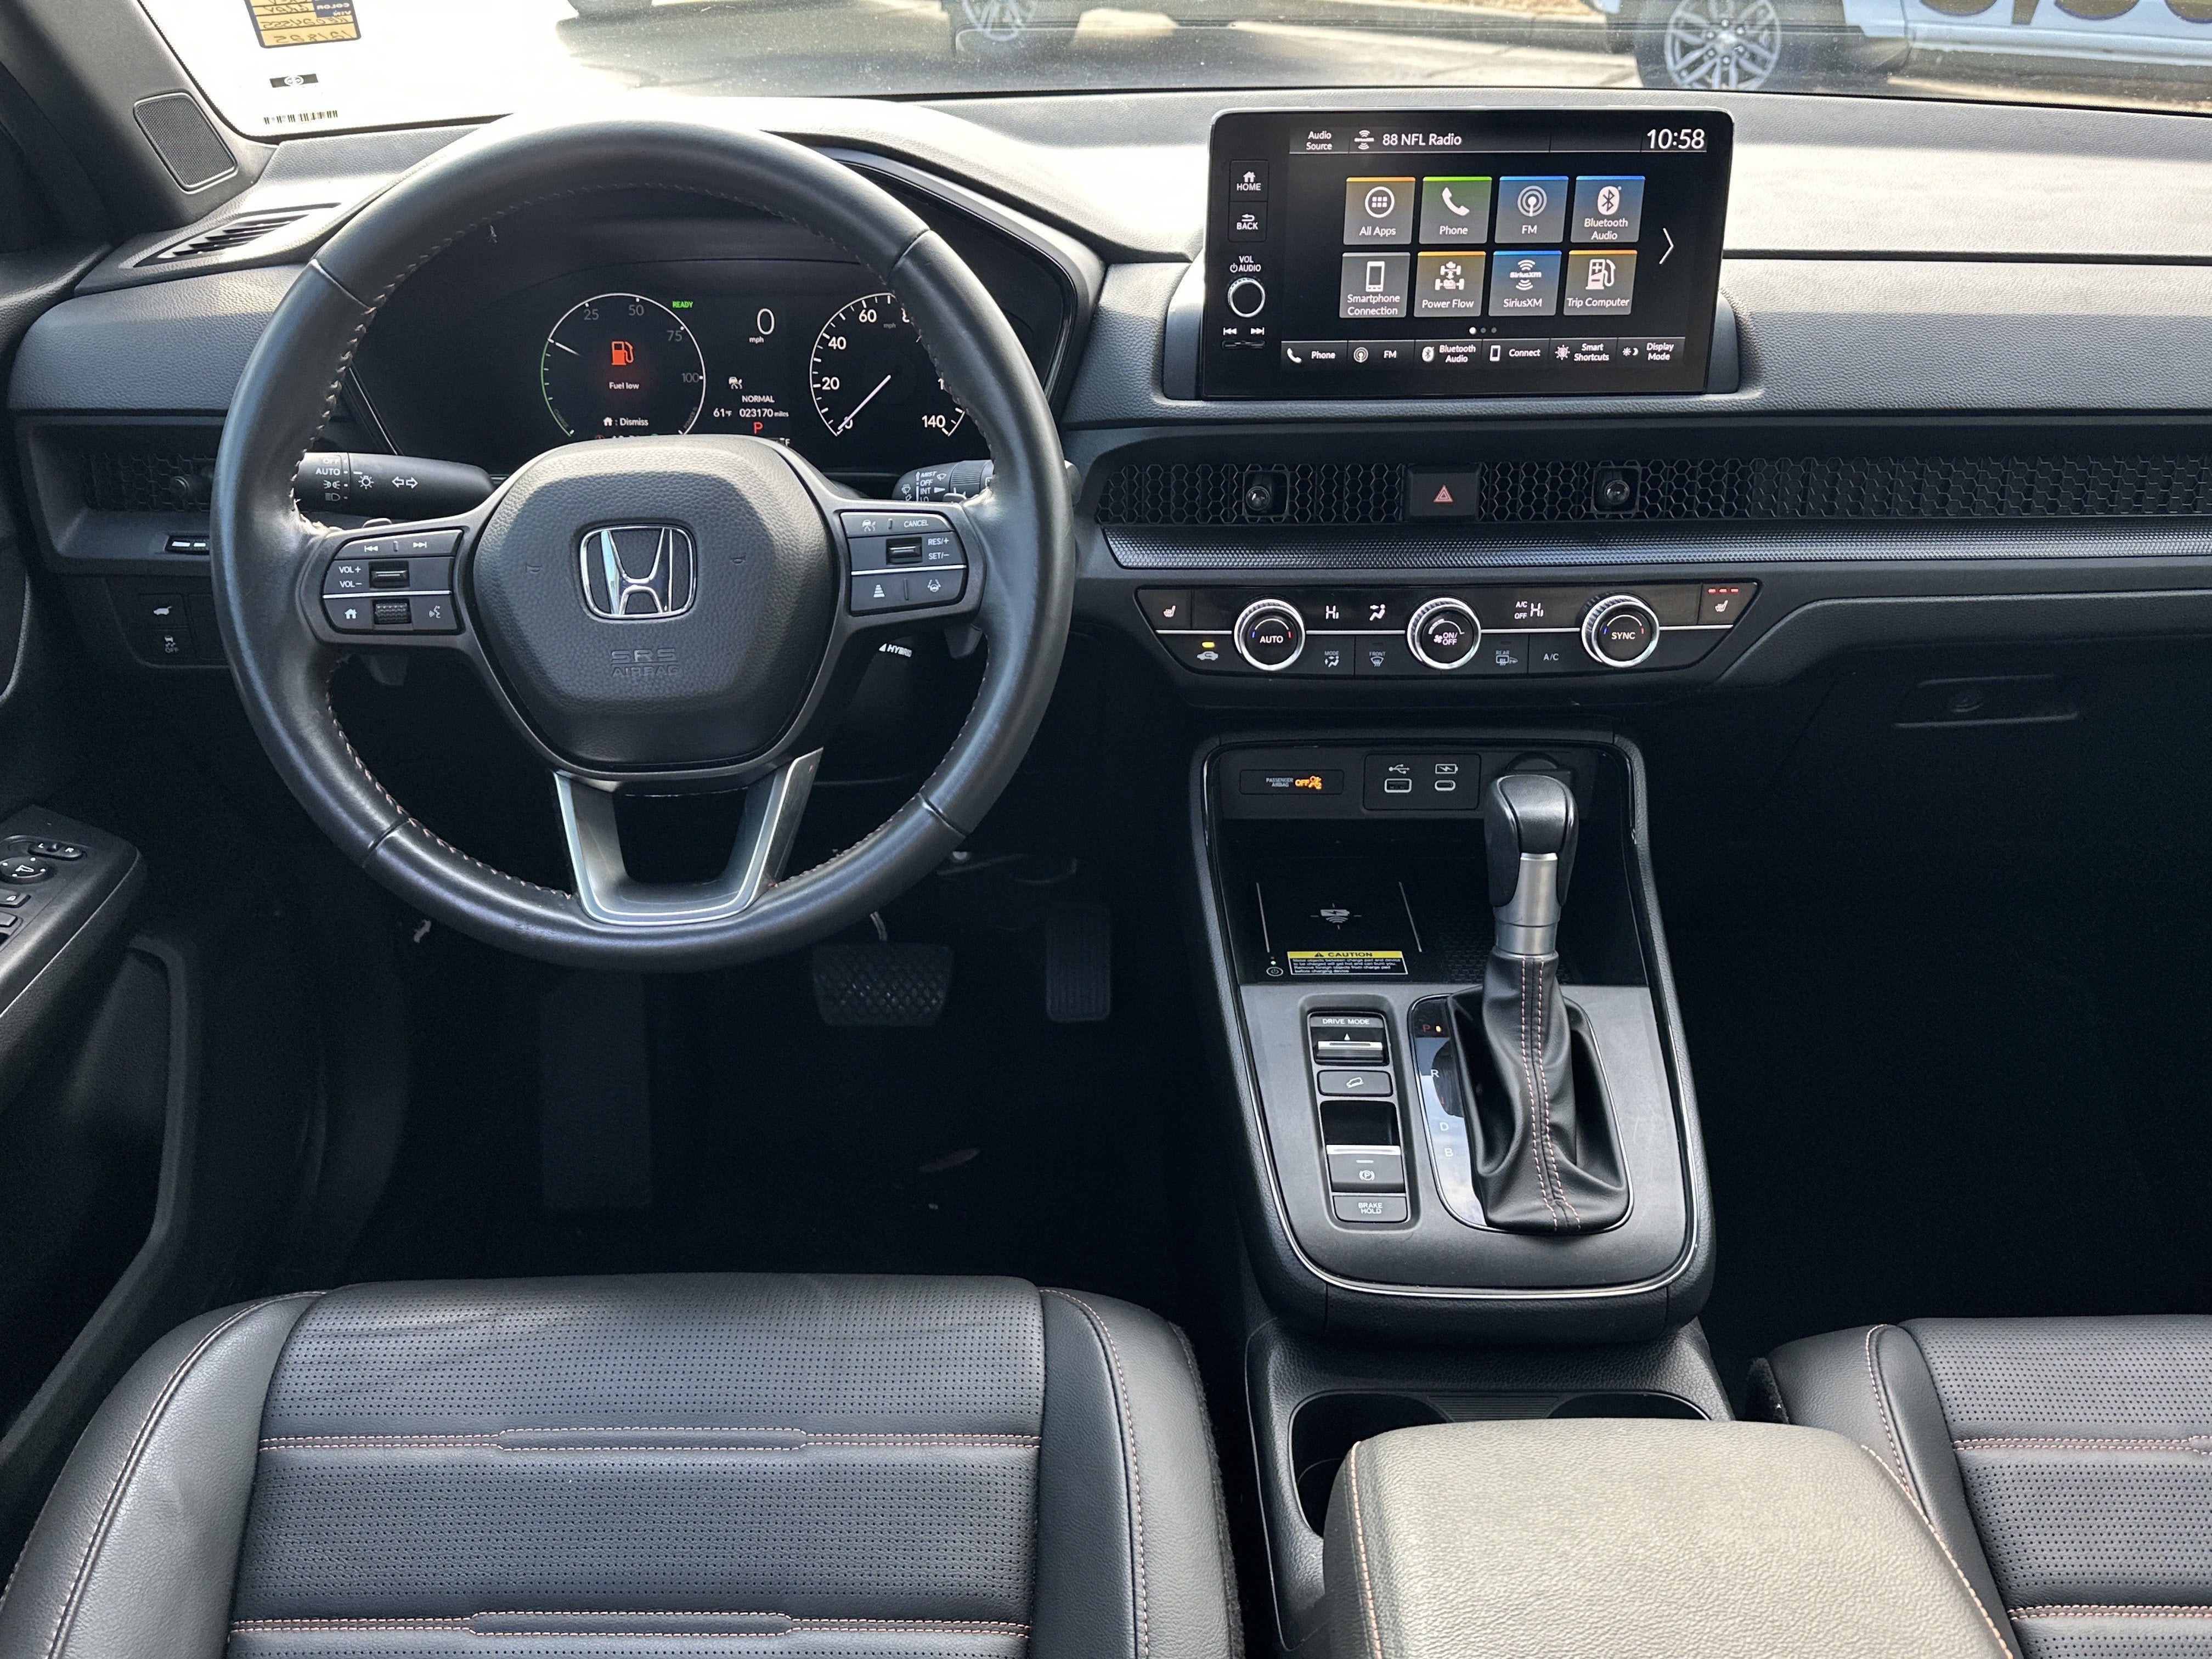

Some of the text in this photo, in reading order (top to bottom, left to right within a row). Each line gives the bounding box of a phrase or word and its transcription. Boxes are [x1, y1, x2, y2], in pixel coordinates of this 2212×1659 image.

[1308, 131, 1331, 140] Audio
[1382, 133, 1398, 146] 88
[1401, 134, 1426, 145] NFL
[1429, 133, 1462, 145] Radio
[1646, 128, 1705, 150] 10:58
[1306, 142, 1333, 151] Source
[1236, 182, 1261, 191] HOME
[1236, 221, 1259, 230] BACK
[1584, 217, 1628, 228] Bluetooth
[1359, 225, 1396, 238] All Apps
[1439, 225, 1469, 236] Phone
[1522, 225, 1538, 235] FM
[1591, 230, 1618, 240] Audio
[1238, 264, 1261, 272] AUDIO
[1347, 294, 1400, 306] Smartphone
[1422, 298, 1474, 309] Power Flow
[1503, 298, 1542, 308] SiriusXM
[1566, 297, 1630, 308] Trip Computer
[583, 309, 599, 320] 25
[628, 304, 644, 316] 50
[1347, 306, 1398, 316] Connection
[757, 308, 774, 335] 0
[859, 310, 877, 323] 60
[667, 330, 683, 342] 75
[828, 337, 847, 349] 40
[1581, 343, 1604, 352] Smart
[1646, 342, 1674, 353] Display
[1384, 350, 1397, 359] FM
[1440, 345, 1476, 354] Bluetooth
[1509, 348, 1541, 358] Connect
[1311, 350, 1336, 360] Phone
[1446, 354, 1469, 363] Audio
[1573, 352, 1610, 362] Shortcuts
[1647, 353, 1671, 362] Mode
[681, 373, 699, 382] 100
[822, 377, 840, 390] 20
[739, 408, 774, 417] 023170
[619, 417, 649, 426] Dismiss
[922, 415, 946, 428] 140
[753, 422, 763, 434] P
[315, 467, 341, 476] AUTO
[1260, 636, 1283, 644] AUTO
[1611, 632, 1635, 640] SYNC
[611, 648, 676, 662] SRS
[1543, 653, 1559, 661] A/C
[612, 665, 679, 677] AIRBAG
[1430, 1069, 1440, 1078] R
[1440, 1122, 1449, 1131] D
[1444, 1148, 1454, 1157] B
